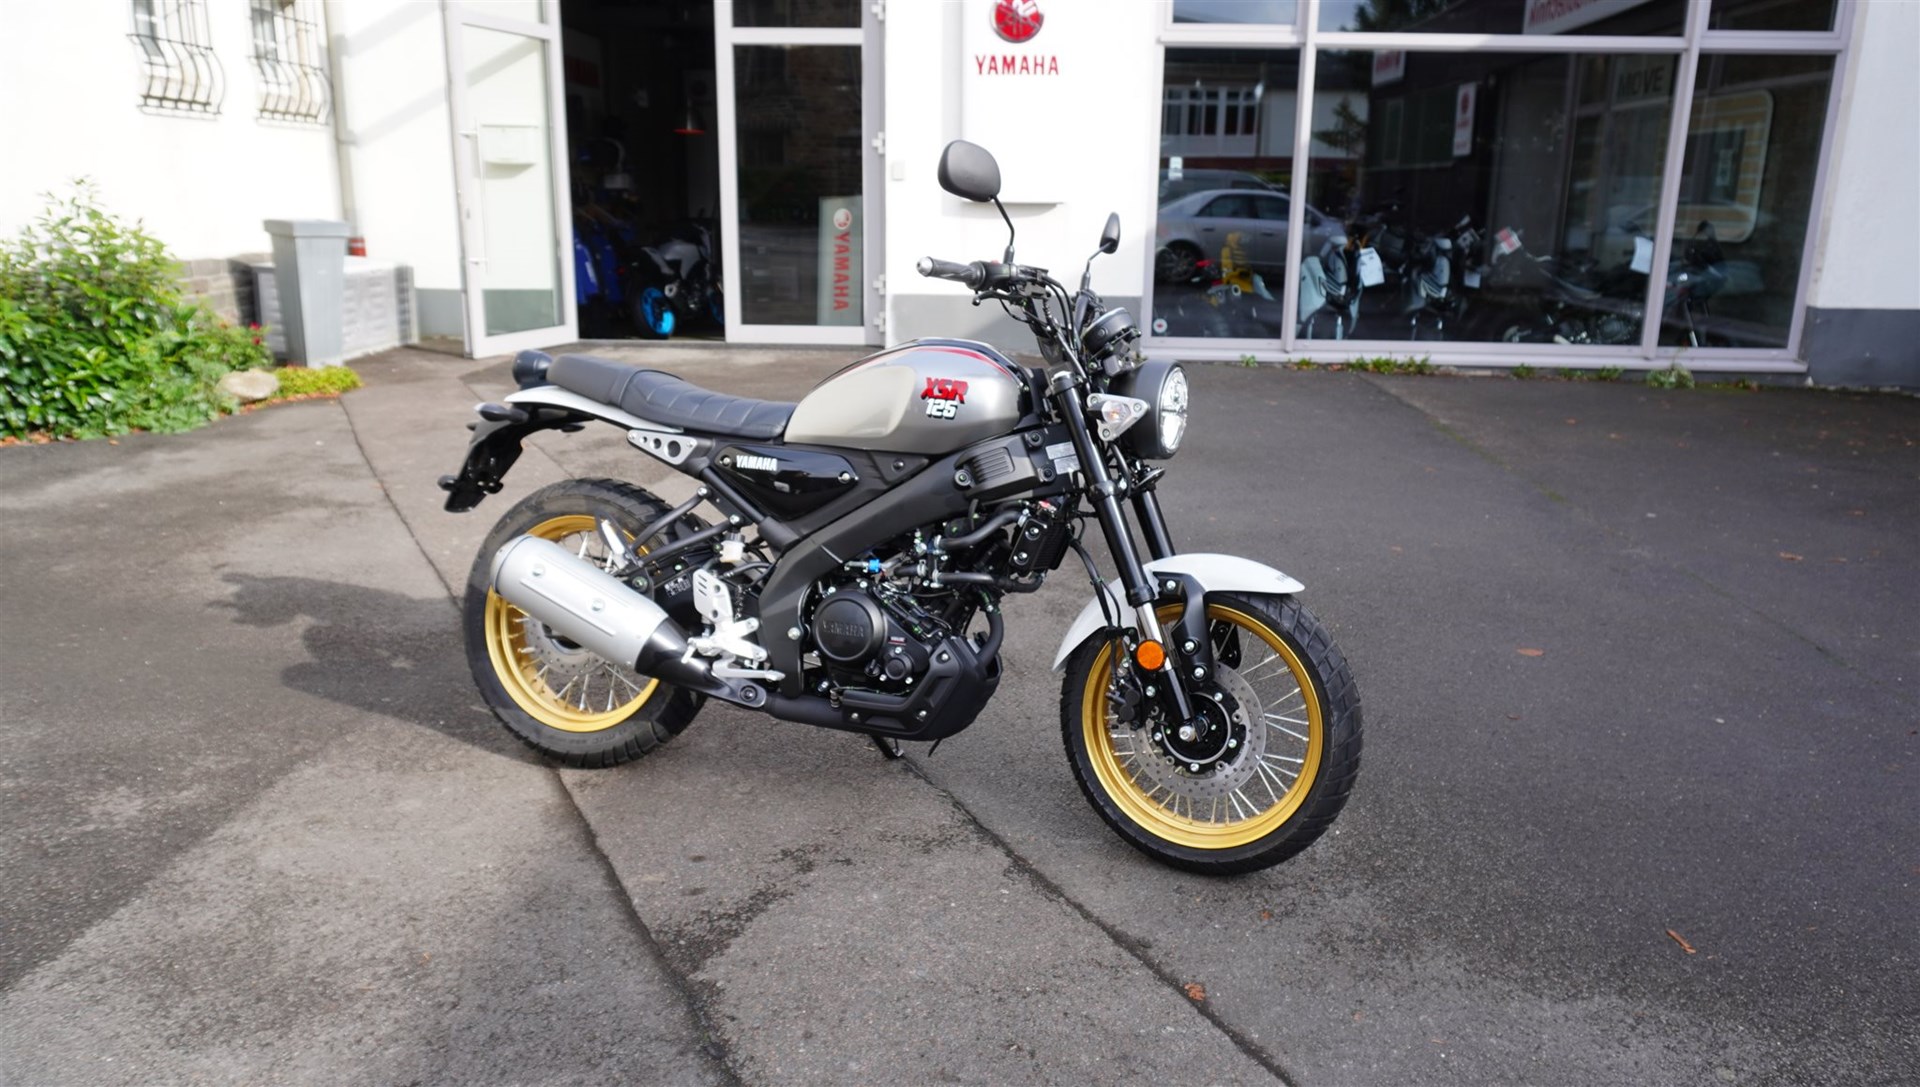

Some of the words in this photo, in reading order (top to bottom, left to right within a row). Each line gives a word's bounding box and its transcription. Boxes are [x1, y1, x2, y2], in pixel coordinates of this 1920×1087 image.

[975, 54, 1059, 76] YAMAHA
[1618, 64, 1665, 97] MOVE
[833, 231, 851, 312] YAMAHA
[921, 377, 969, 404] XSR
[925, 398, 958, 420] 125
[736, 454, 778, 472] YAMAHA
[822, 619, 865, 638] YAMAHA
